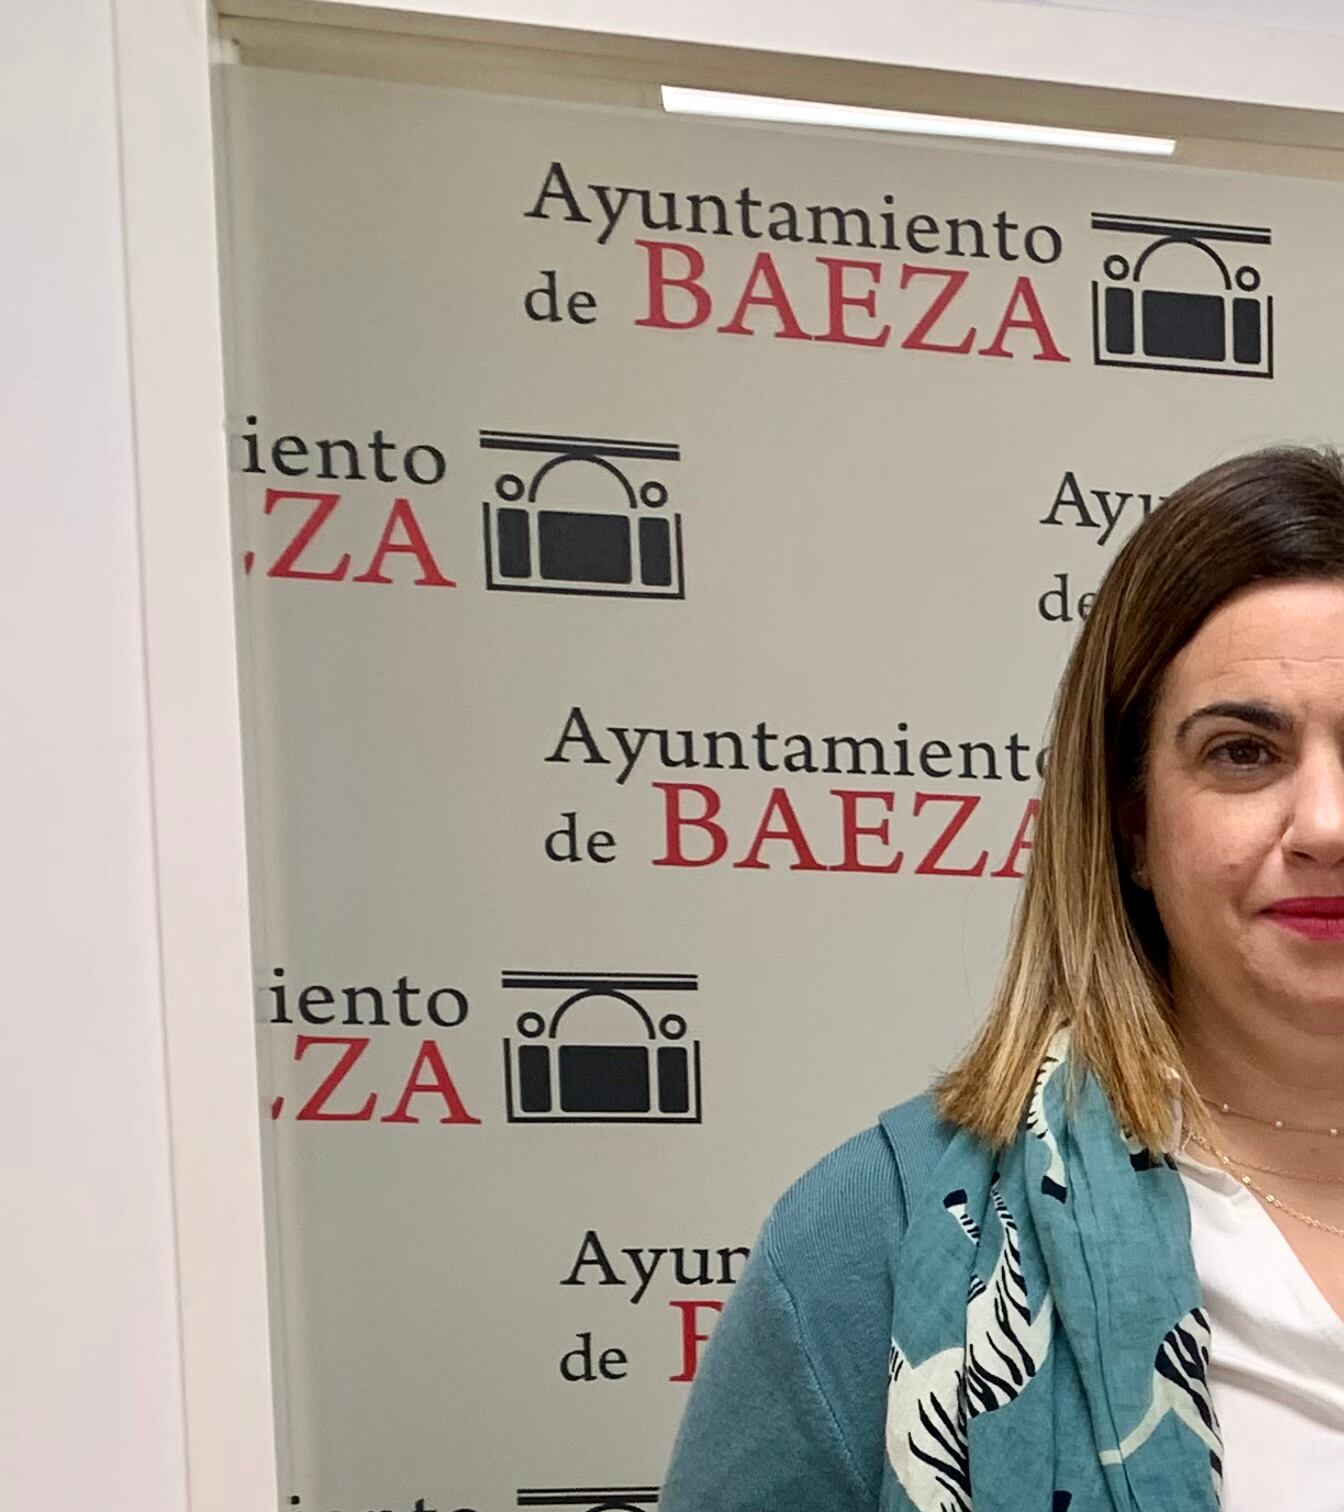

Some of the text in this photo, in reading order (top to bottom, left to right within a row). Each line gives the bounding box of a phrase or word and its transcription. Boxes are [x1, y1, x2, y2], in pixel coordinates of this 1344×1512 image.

[523, 161, 1062, 264] Ayuntamiento
[523, 239, 1070, 363] de BAEZA
[244, 488, 457, 588] ZA
[544, 706, 1050, 783] Ayuntamient
[544, 811, 617, 864] de
[271, 1034, 482, 1125] ZA
[560, 1332, 628, 1382] de
